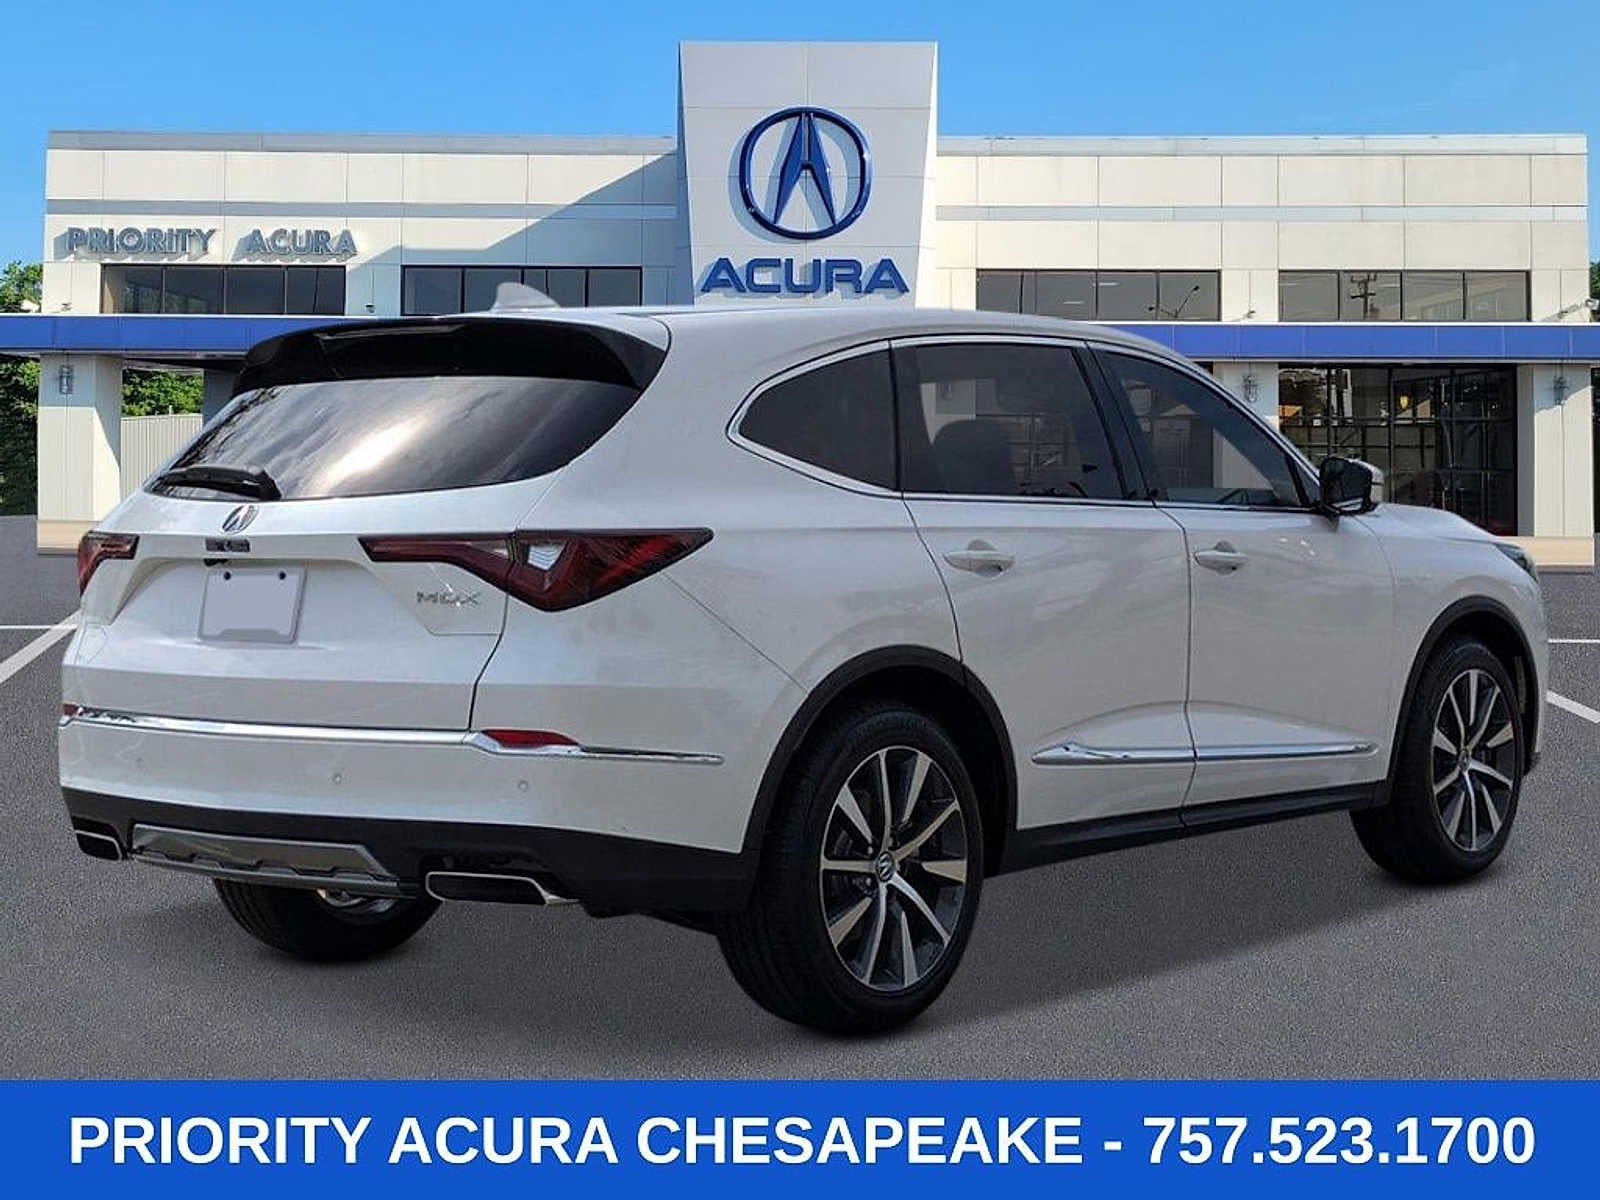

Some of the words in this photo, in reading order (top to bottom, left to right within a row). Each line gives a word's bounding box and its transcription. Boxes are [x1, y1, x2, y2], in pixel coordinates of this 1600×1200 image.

[66, 227, 216, 254] PRIORITY
[249, 229, 357, 256] ACURA
[701, 257, 910, 294] ACURA
